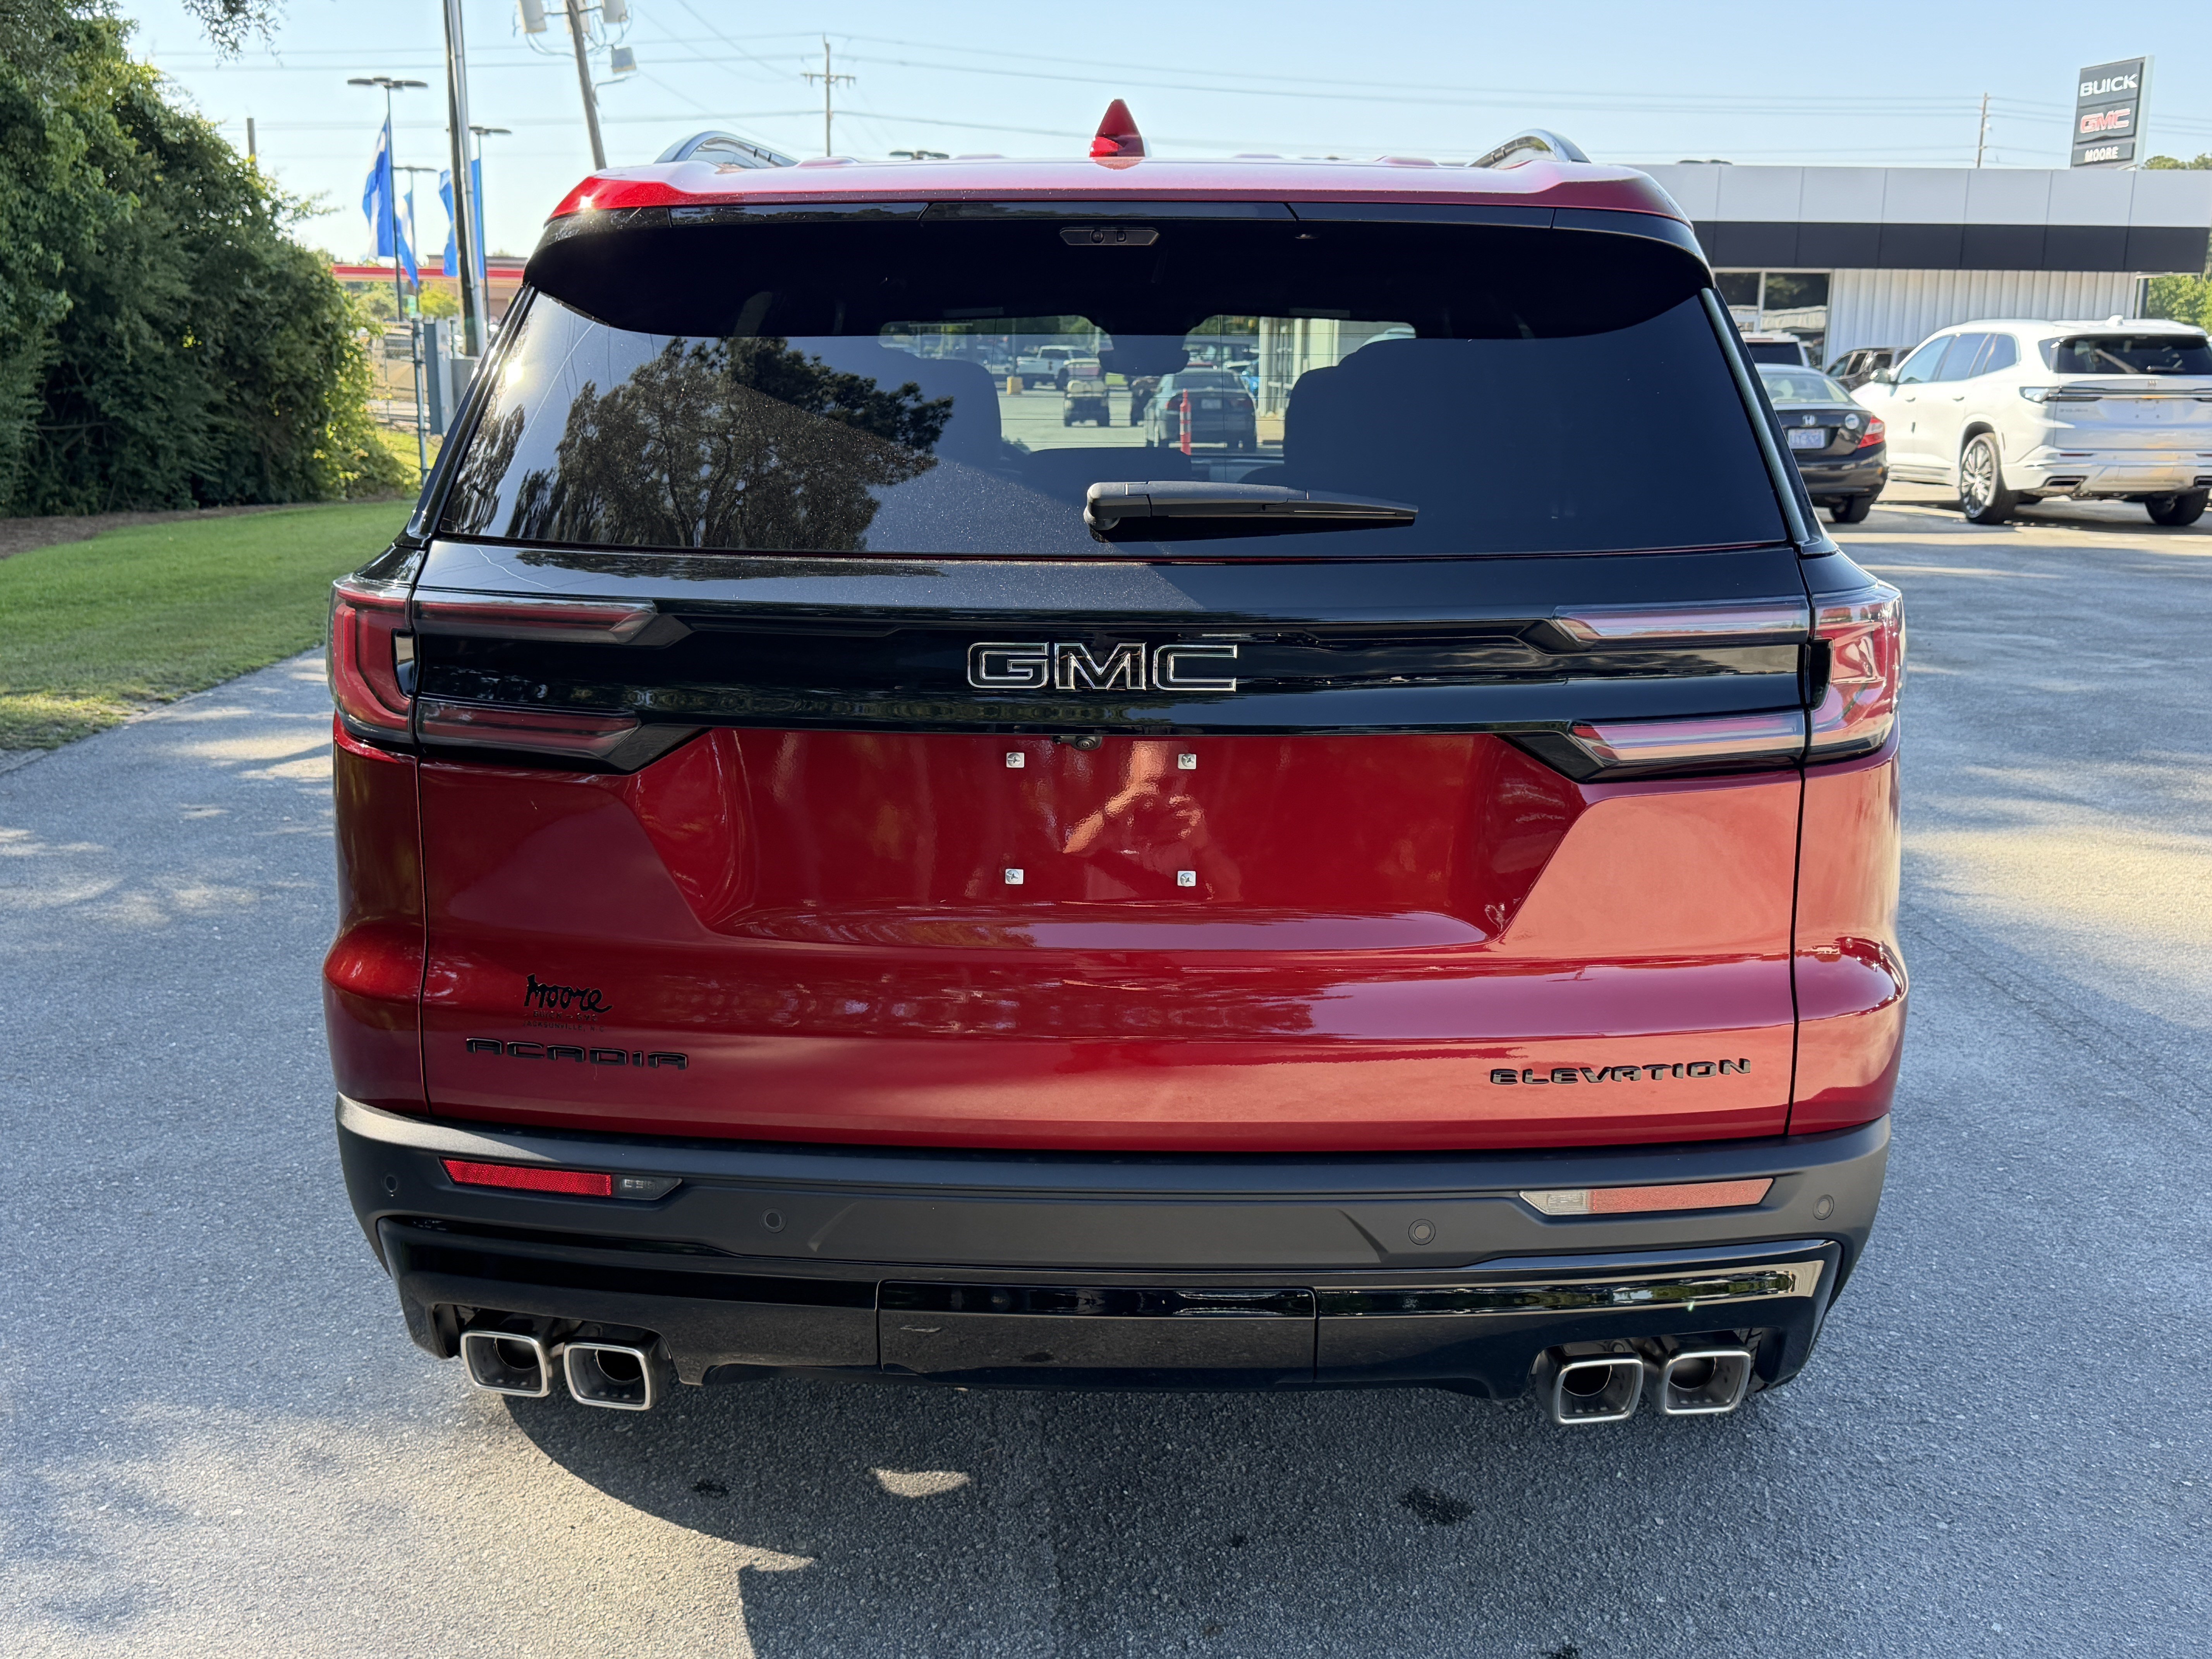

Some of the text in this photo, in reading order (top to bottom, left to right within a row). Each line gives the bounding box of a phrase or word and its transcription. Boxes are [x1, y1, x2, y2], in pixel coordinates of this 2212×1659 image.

[2080, 73, 2138, 97] BUICK
[2080, 108, 2131, 133] GMC
[2085, 146, 2119, 162] MOORE
[967, 642, 1237, 692] GMC
[533, 1011, 562, 1019] BUICK
[466, 1037, 688, 1070] ACADIA
[1490, 1058, 1751, 1084] ELEVATION
